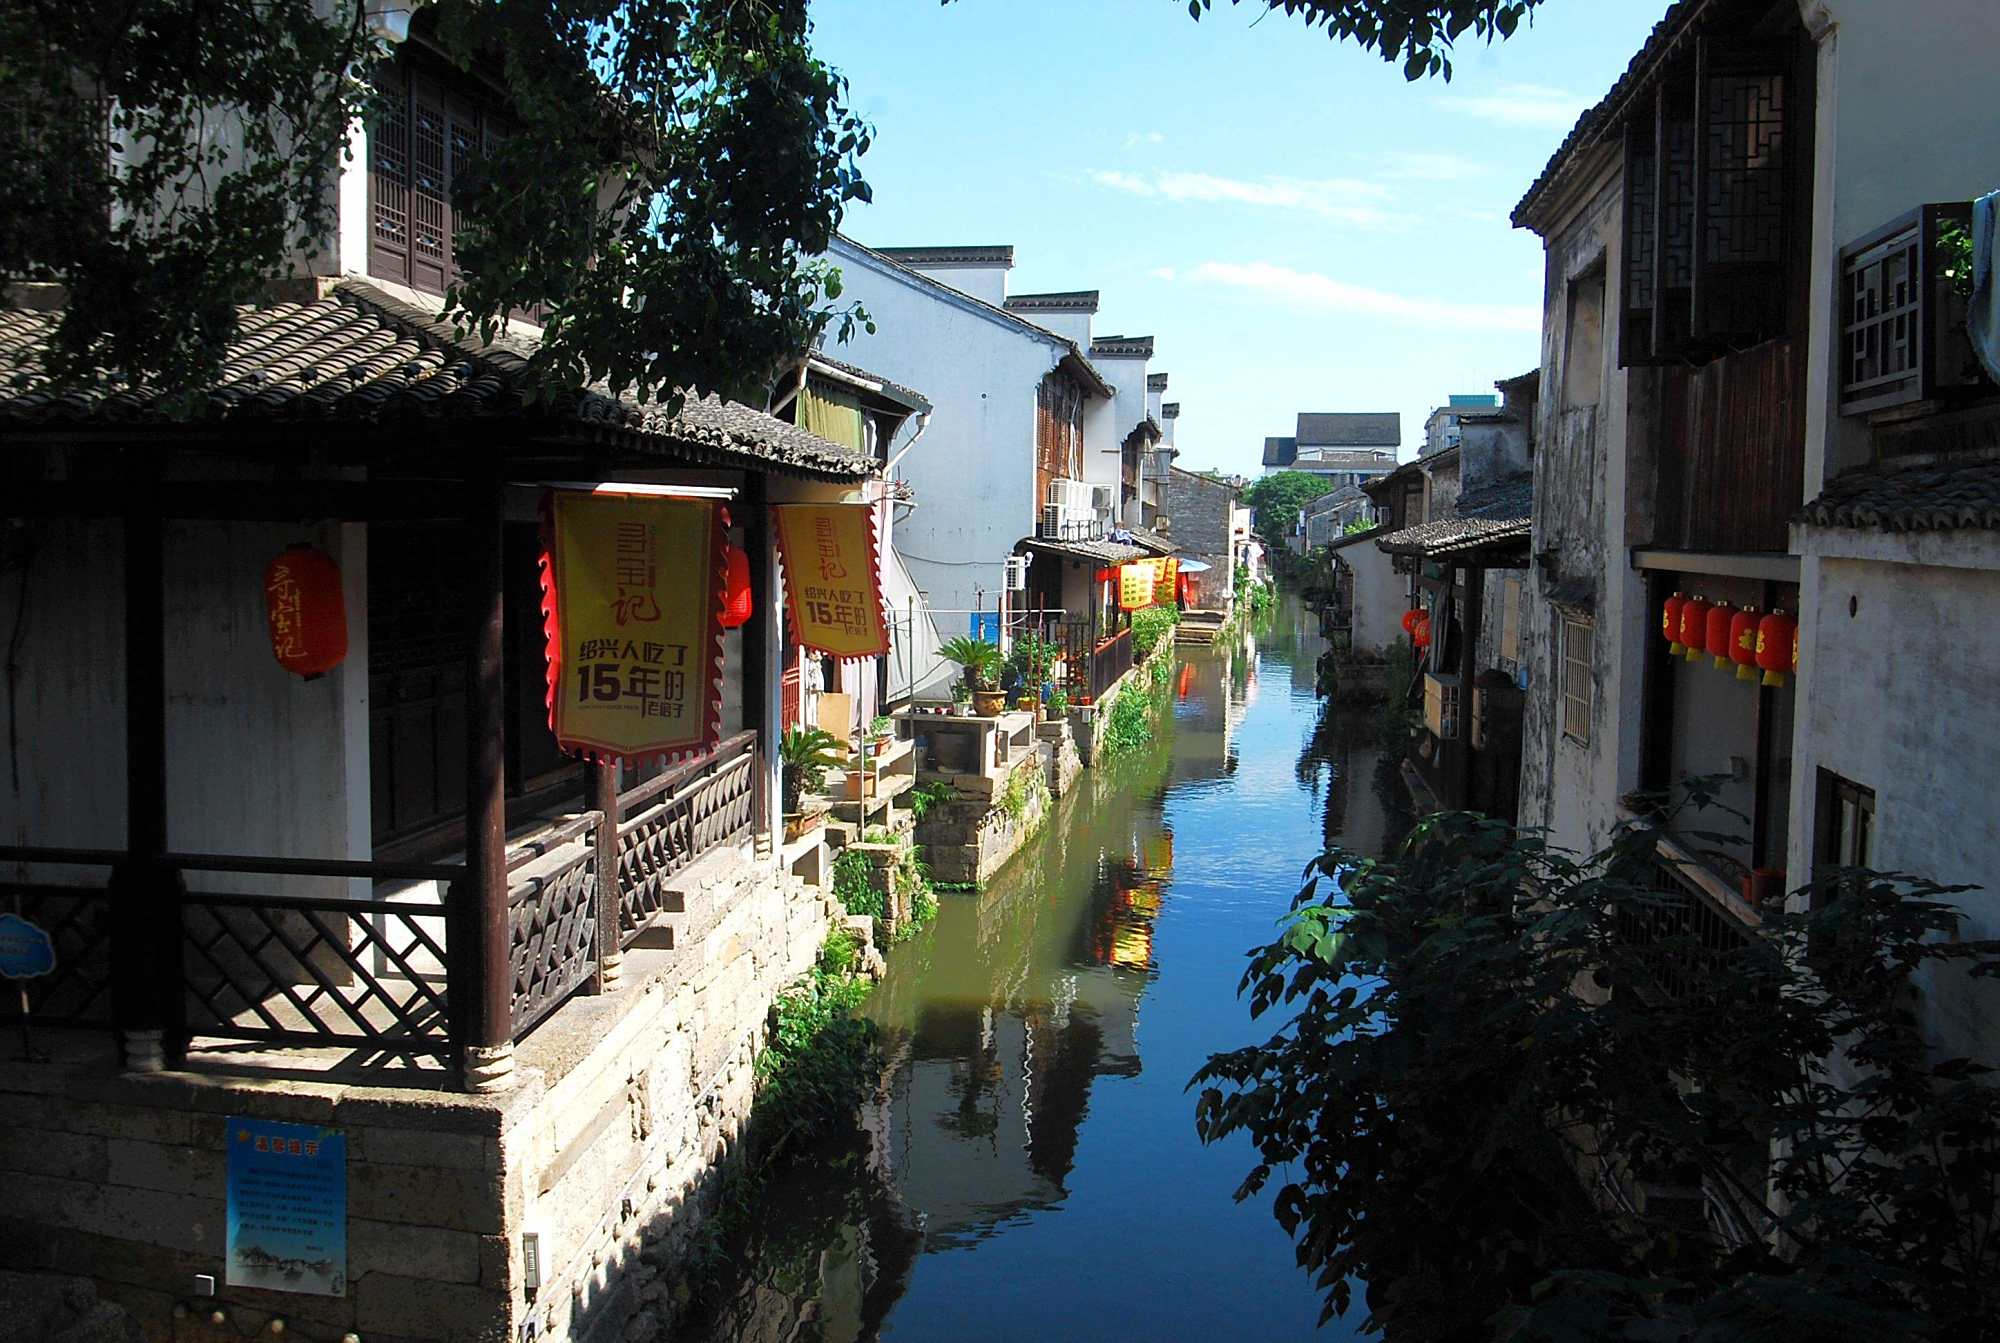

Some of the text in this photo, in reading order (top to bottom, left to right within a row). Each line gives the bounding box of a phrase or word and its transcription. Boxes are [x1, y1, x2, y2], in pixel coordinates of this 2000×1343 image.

[579, 638, 687, 665] 绍兴人吃了
[577, 663, 685, 716] 15年的
